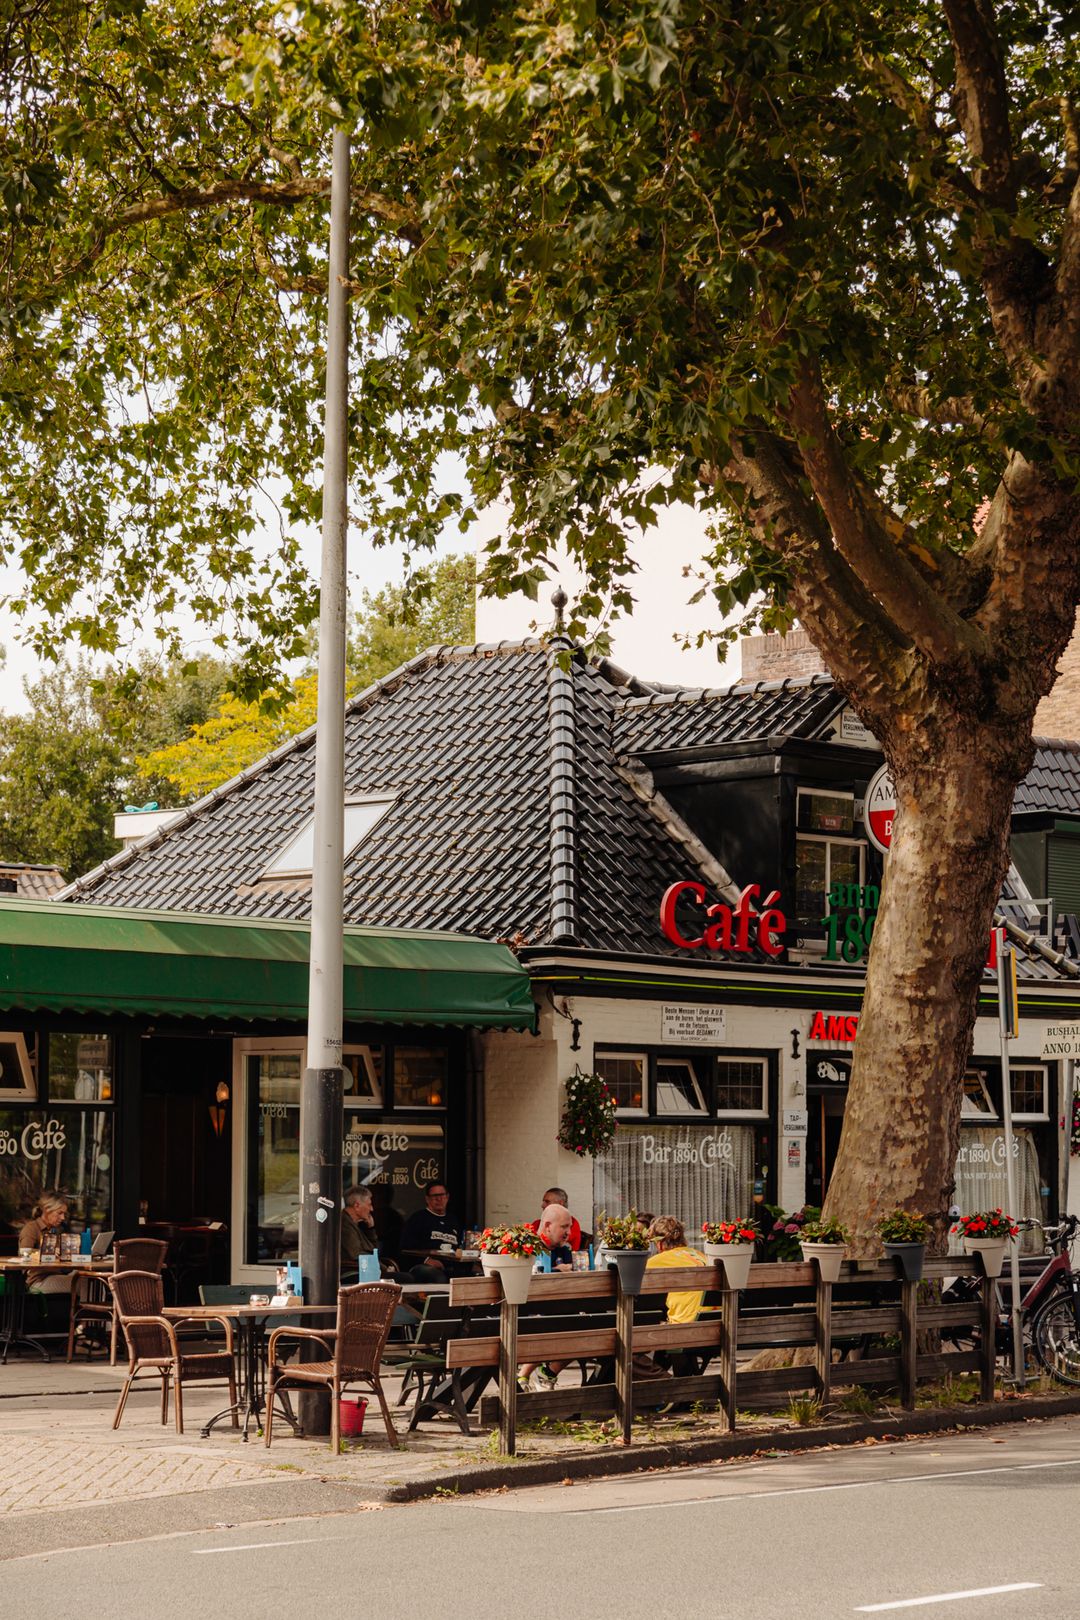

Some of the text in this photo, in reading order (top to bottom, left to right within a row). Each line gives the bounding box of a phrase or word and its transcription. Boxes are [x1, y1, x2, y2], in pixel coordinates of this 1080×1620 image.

[660, 880, 787, 956] Café
[1043, 1043, 1071, 1054] ANNO
[21, 1119, 67, 1160] Café
[342, 1140, 370, 1157] 1890
[640, 1132, 733, 1168] Bar 1890 Café
[969, 1149, 990, 1163] 1890
[392, 1174, 410, 1185] 1890
[413, 1158, 439, 1189] Café
